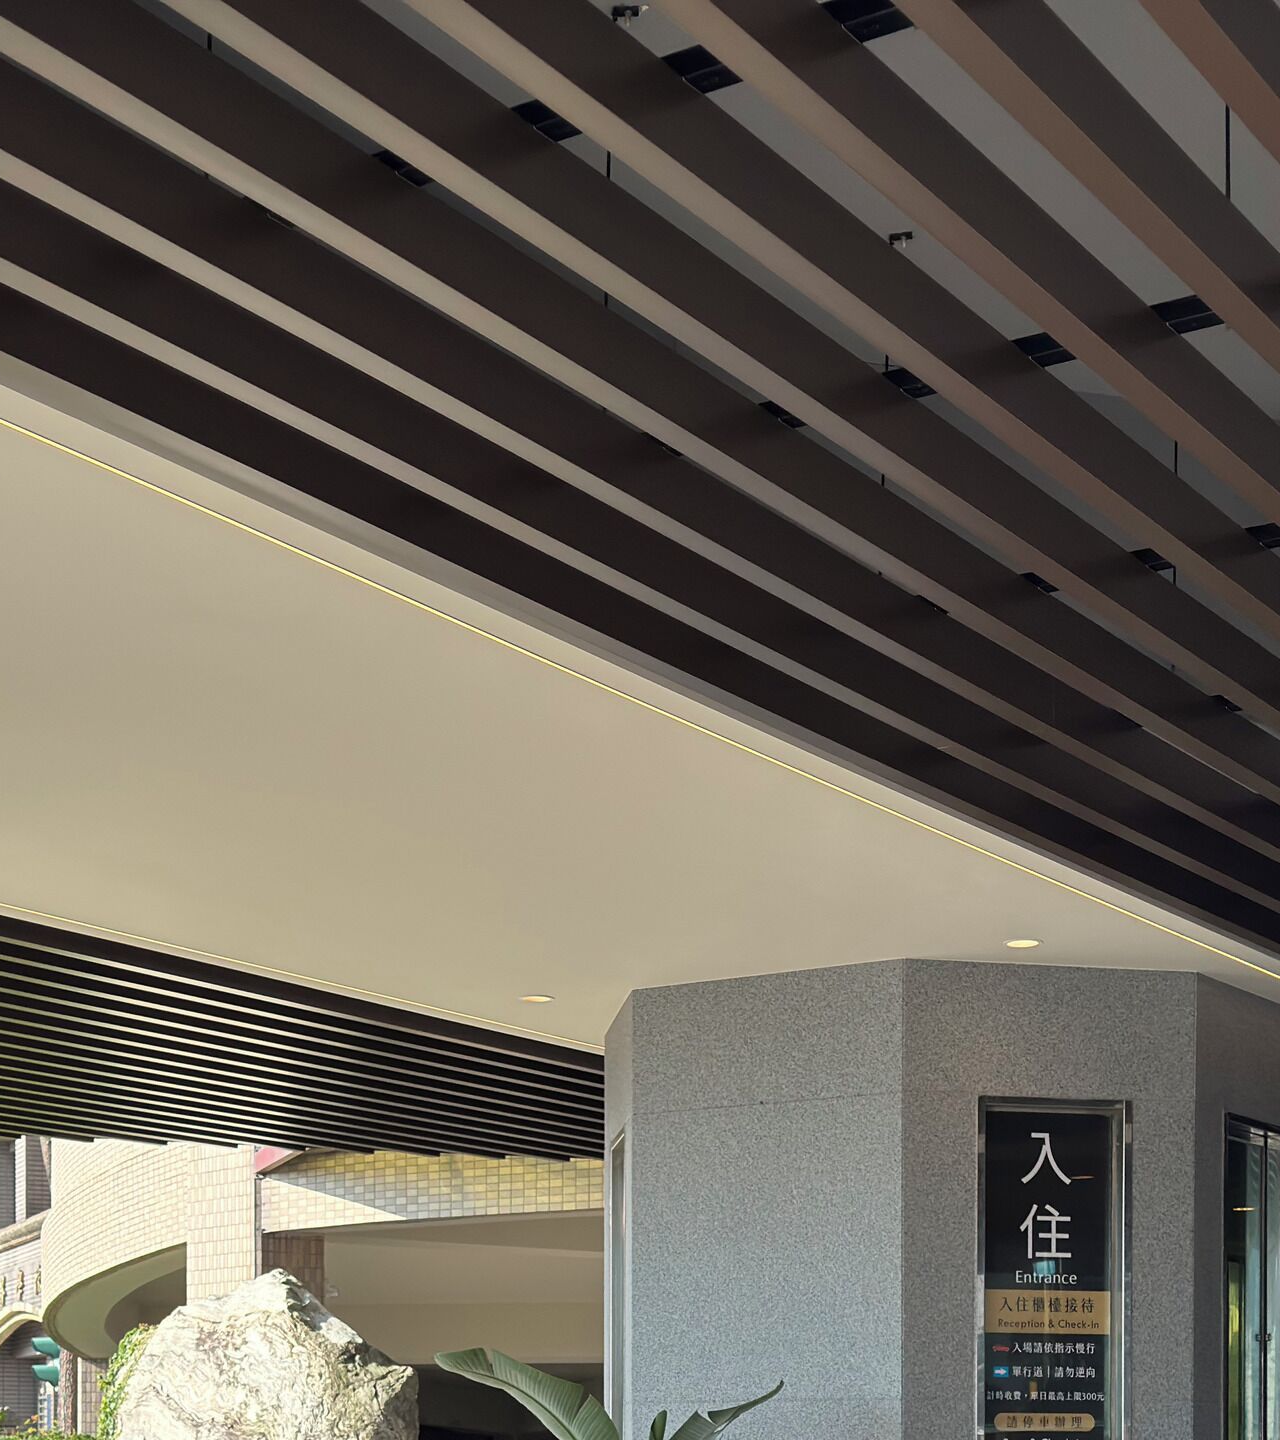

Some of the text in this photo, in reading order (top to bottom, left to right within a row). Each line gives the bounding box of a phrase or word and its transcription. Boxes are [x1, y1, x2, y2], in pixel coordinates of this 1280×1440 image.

[1020, 1132, 1072, 1260] 入住
[1015, 1270, 1078, 1285] Entrance
[998, 1318, 1045, 1331] Reception
[1048, 1319, 1056, 1329] &
[1012, 1342, 1096, 1355] 入場請依指示慢行
[1012, 1366, 1044, 1378] 單行道
[1054, 1366, 1096, 1378] 請勿逆向
[1006, 1415, 1082, 1428] 請停車辦理
